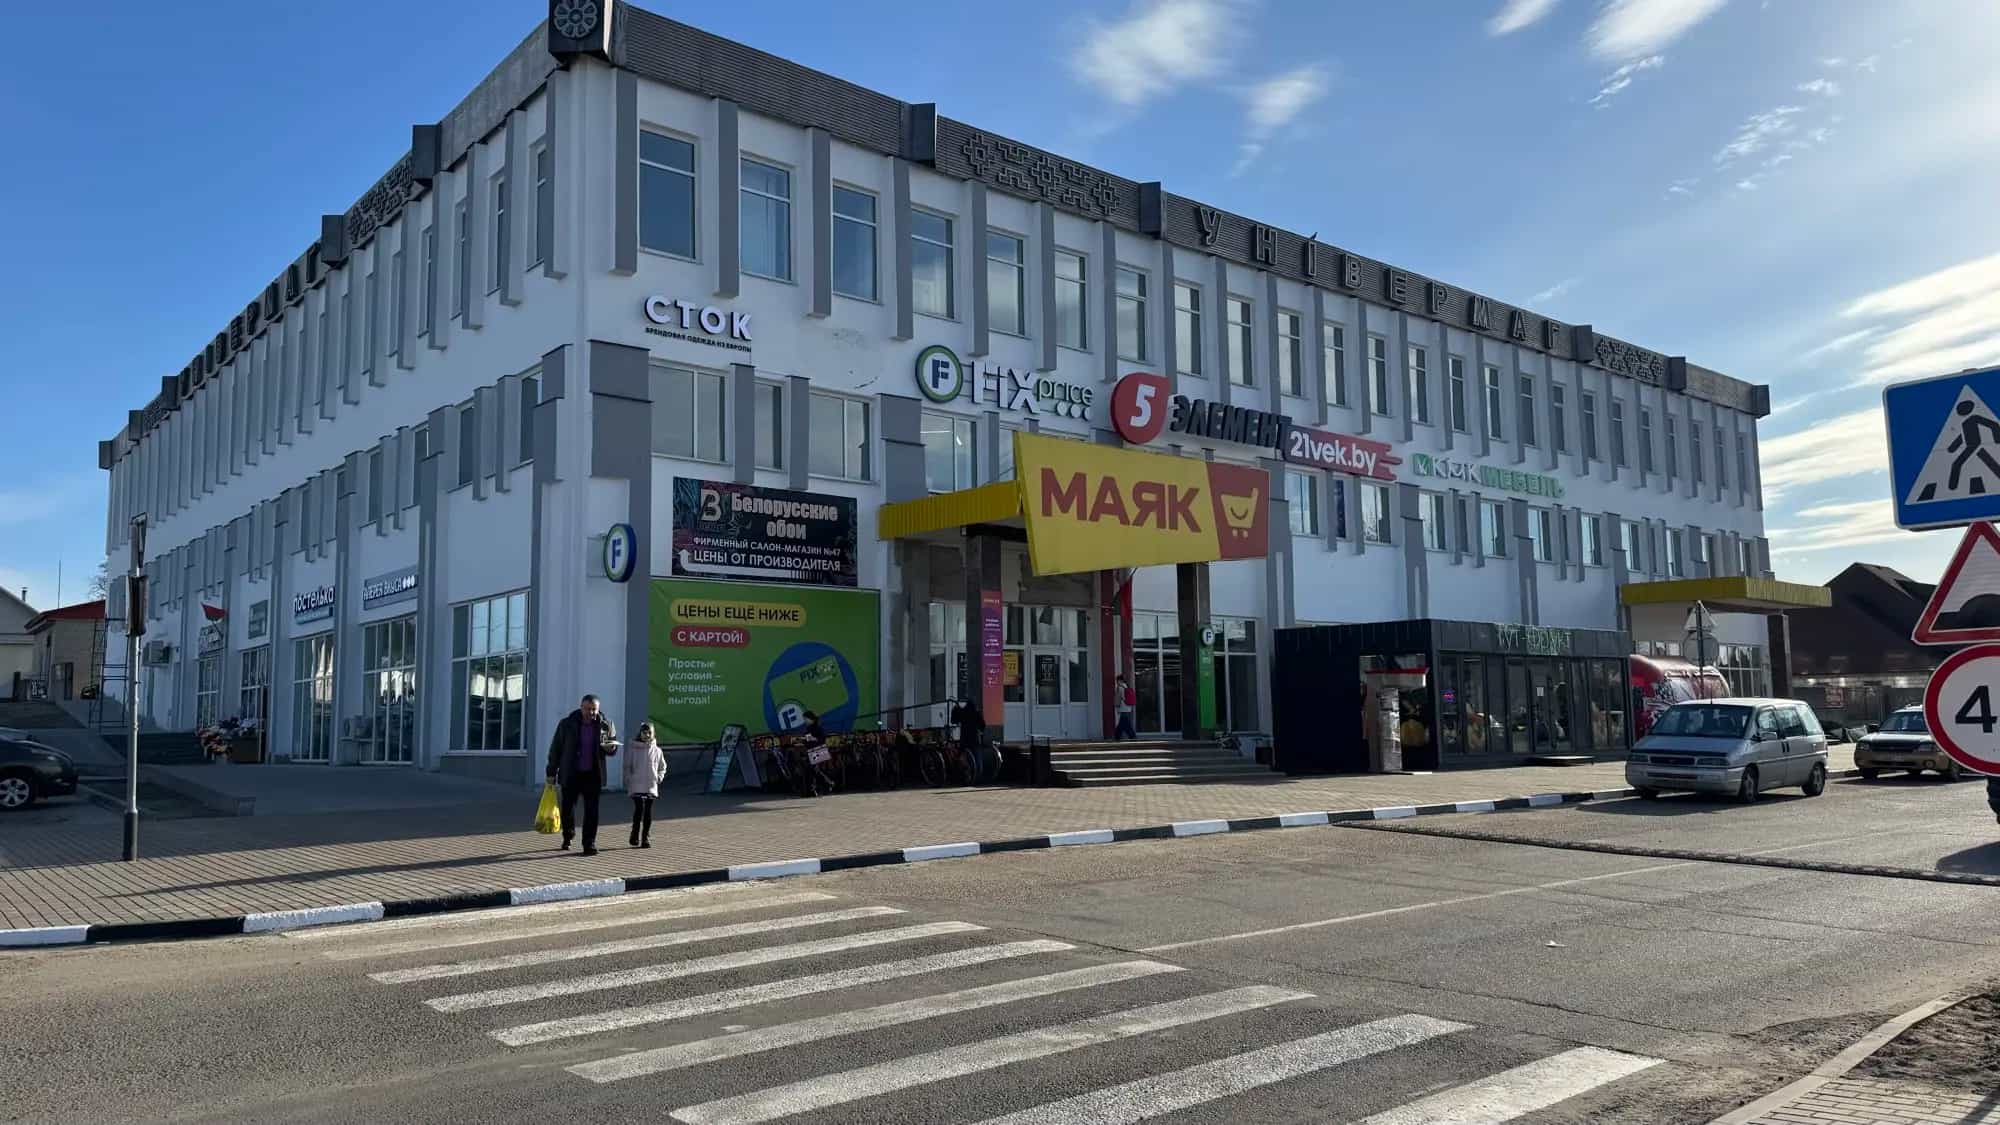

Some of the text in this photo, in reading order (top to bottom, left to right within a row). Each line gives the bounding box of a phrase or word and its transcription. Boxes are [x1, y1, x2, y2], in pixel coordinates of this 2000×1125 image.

[1199, 206, 1561, 350] УНІВЕРМАГ
[644, 295, 752, 341] СТОК
[1130, 383, 1293, 455] 5 ЭЛЕМЕНТ
[1289, 430, 1378, 476] 21vek.by
[731, 492, 838, 522] Белорусские
[1041, 467, 1202, 533] МАЯК
[765, 519, 807, 540] обои
[693, 536, 749, 550] ФИРМЕННЫЙ
[750, 542, 822, 556] САЛОН-МАГАЗИН
[693, 550, 841, 572] ЦЕНЫ ОТ ПРОИЗВОДИТЕЛЯ
[677, 604, 799, 621] ЦЕНЫ ЕЩЁ НИЖЕ
[677, 630, 744, 644] С КАРТОЙ!
[668, 658, 716, 670] Простые
[668, 672, 712, 682] условия
[668, 684, 726, 694] очевидная
[668, 694, 711, 706] выгода!
